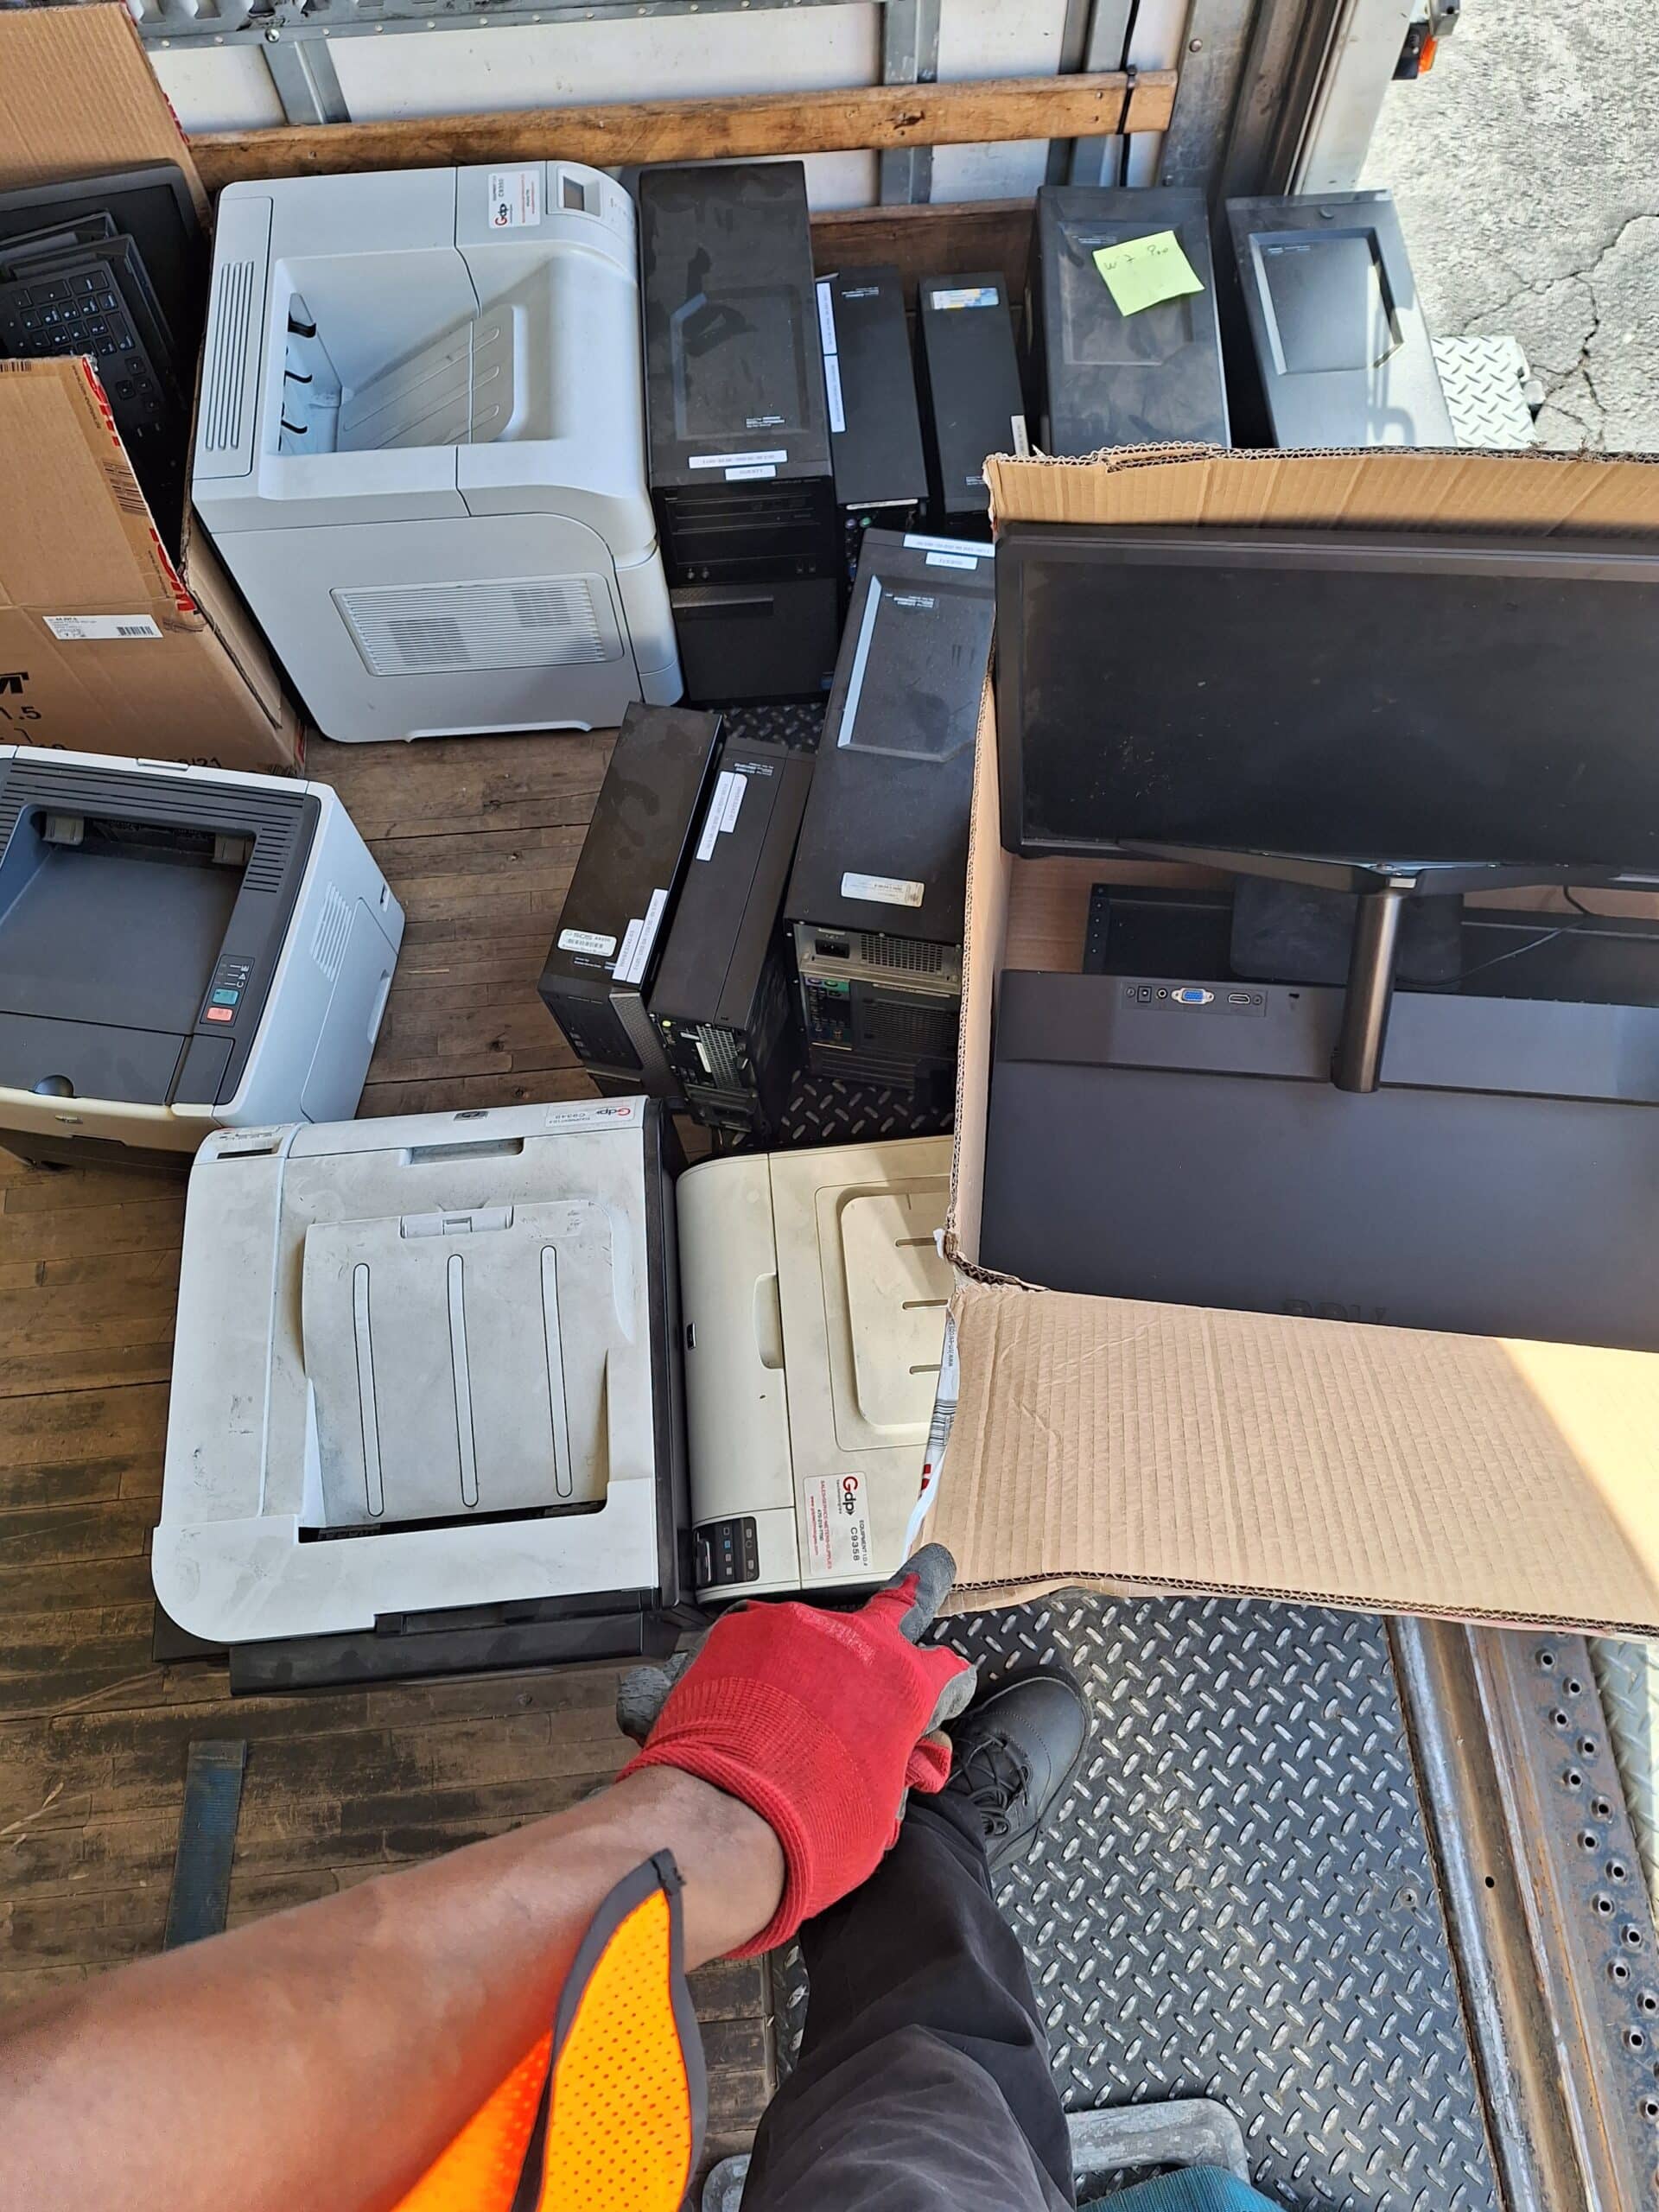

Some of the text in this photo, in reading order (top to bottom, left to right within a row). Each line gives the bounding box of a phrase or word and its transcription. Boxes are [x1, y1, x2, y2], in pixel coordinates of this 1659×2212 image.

[842, 1476, 859, 1515] Gdp
[850, 1527, 861, 1561] C9358
[859, 1519, 868, 1554] EQUIPMENT
